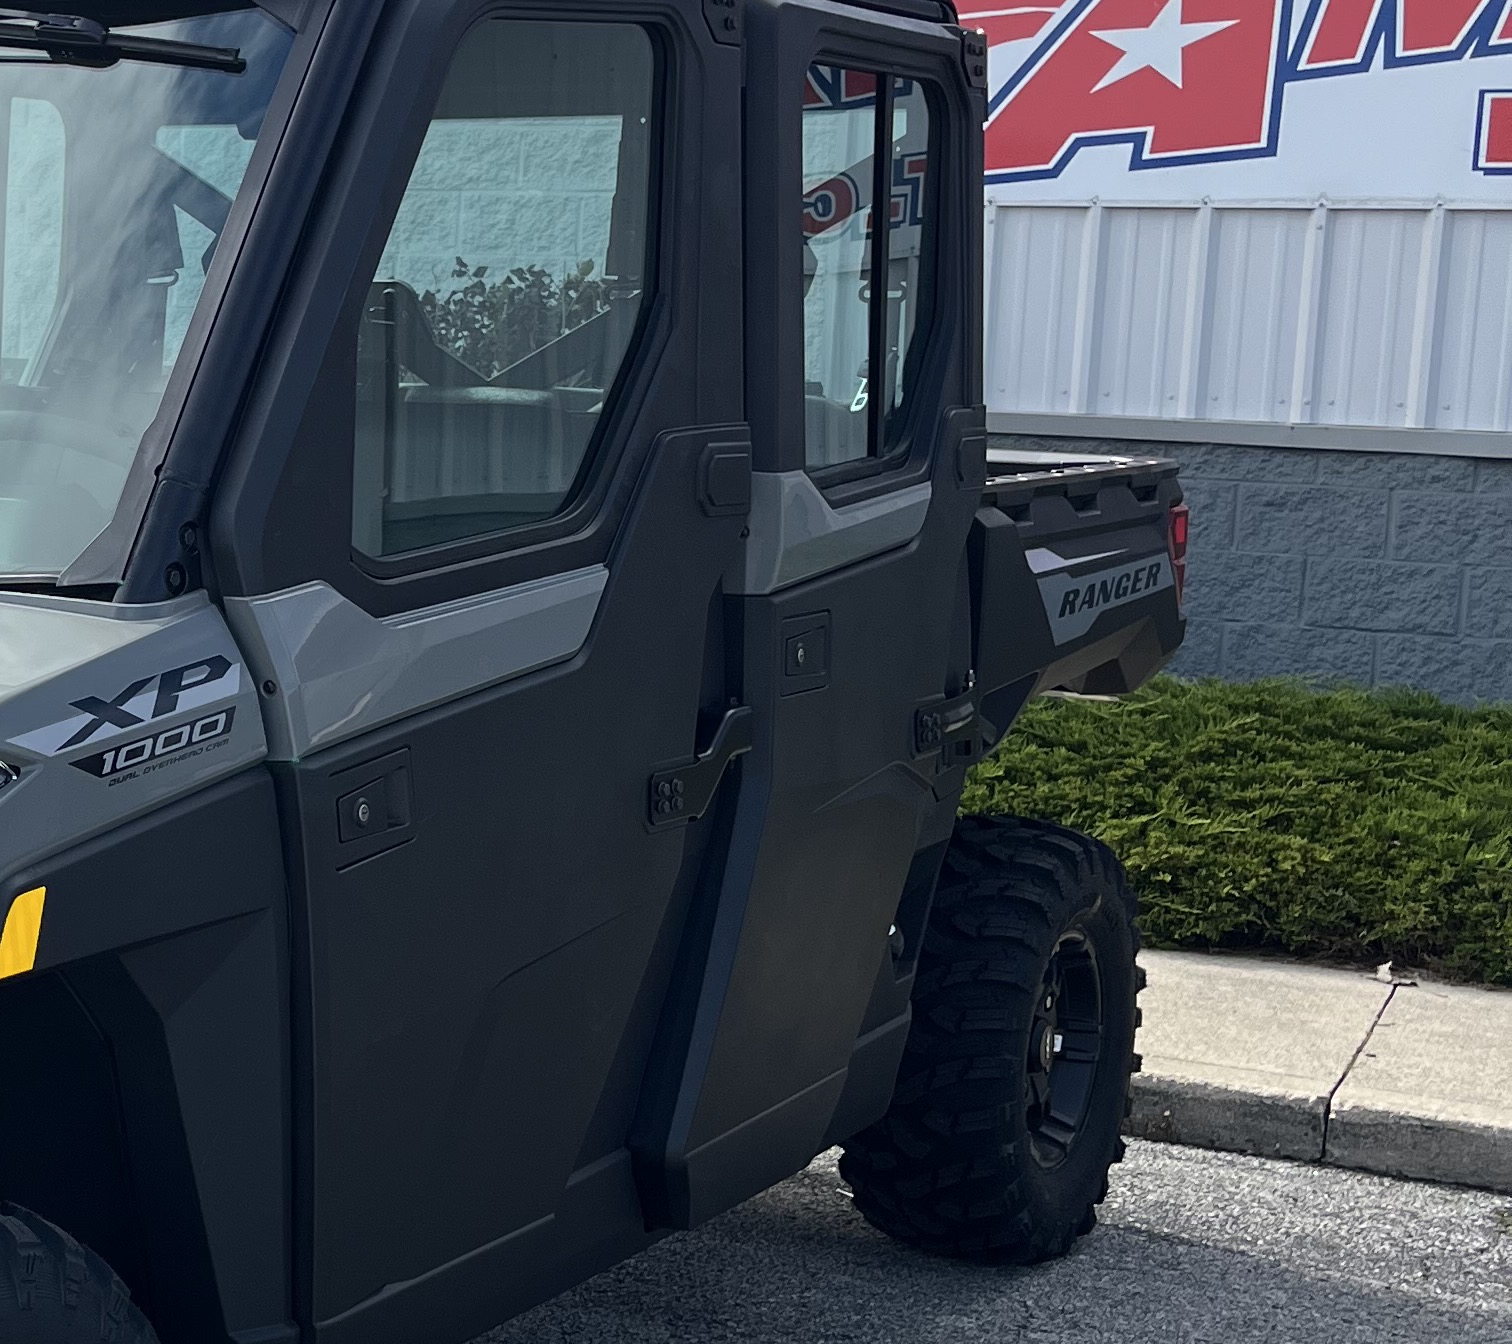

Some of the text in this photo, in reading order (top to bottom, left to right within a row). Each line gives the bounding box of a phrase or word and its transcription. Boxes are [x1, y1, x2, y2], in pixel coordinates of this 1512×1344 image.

[1058, 562, 1161, 619] RANGER
[55, 654, 233, 753] XP
[102, 712, 227, 775] 1000
[108, 738, 230, 788] DUAL OVERHEAD CAM
